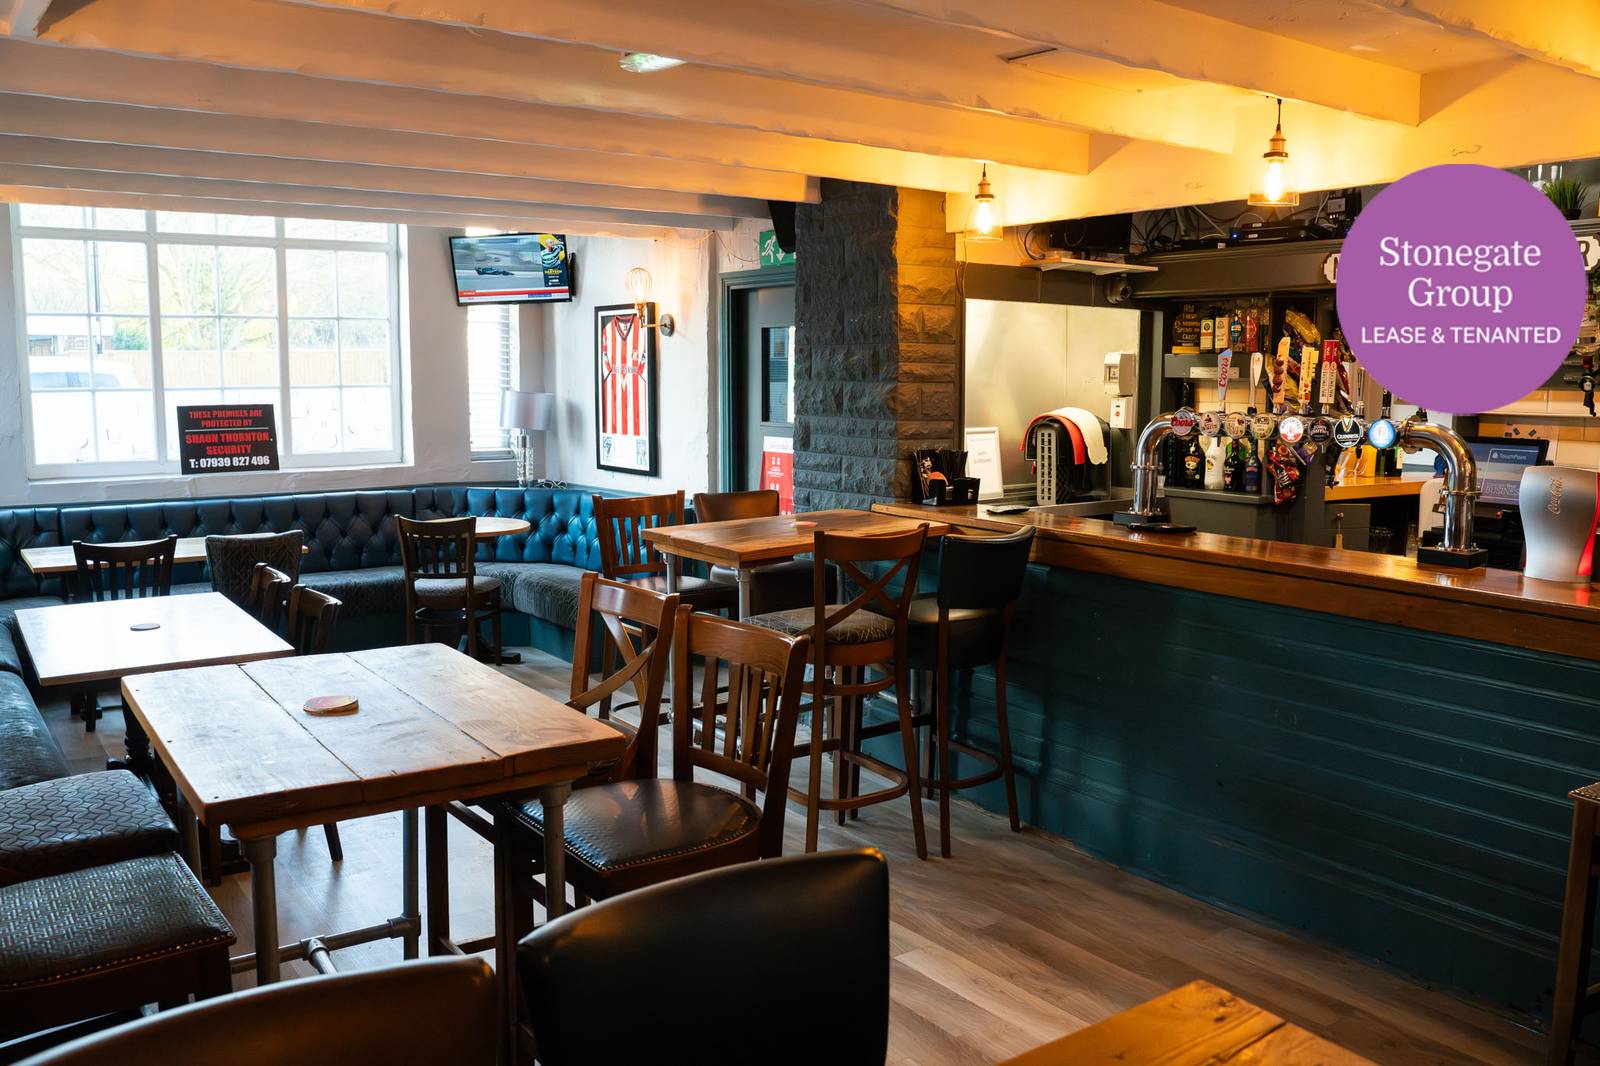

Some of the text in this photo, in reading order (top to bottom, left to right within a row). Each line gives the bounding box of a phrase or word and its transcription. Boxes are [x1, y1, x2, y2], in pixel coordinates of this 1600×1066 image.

[1218, 357, 1229, 387] Coors
[189, 409, 263, 419] THESE PREMISES ARE
[201, 419, 242, 428] PROTECTED
[1171, 416, 1194, 427] Coors
[185, 431, 269, 444] SHAUN THORNTON
[206, 444, 251, 455] SECURITY
[189, 458, 199, 469] T:
[200, 457, 231, 468] 07939
[251, 455, 270, 466] 496
